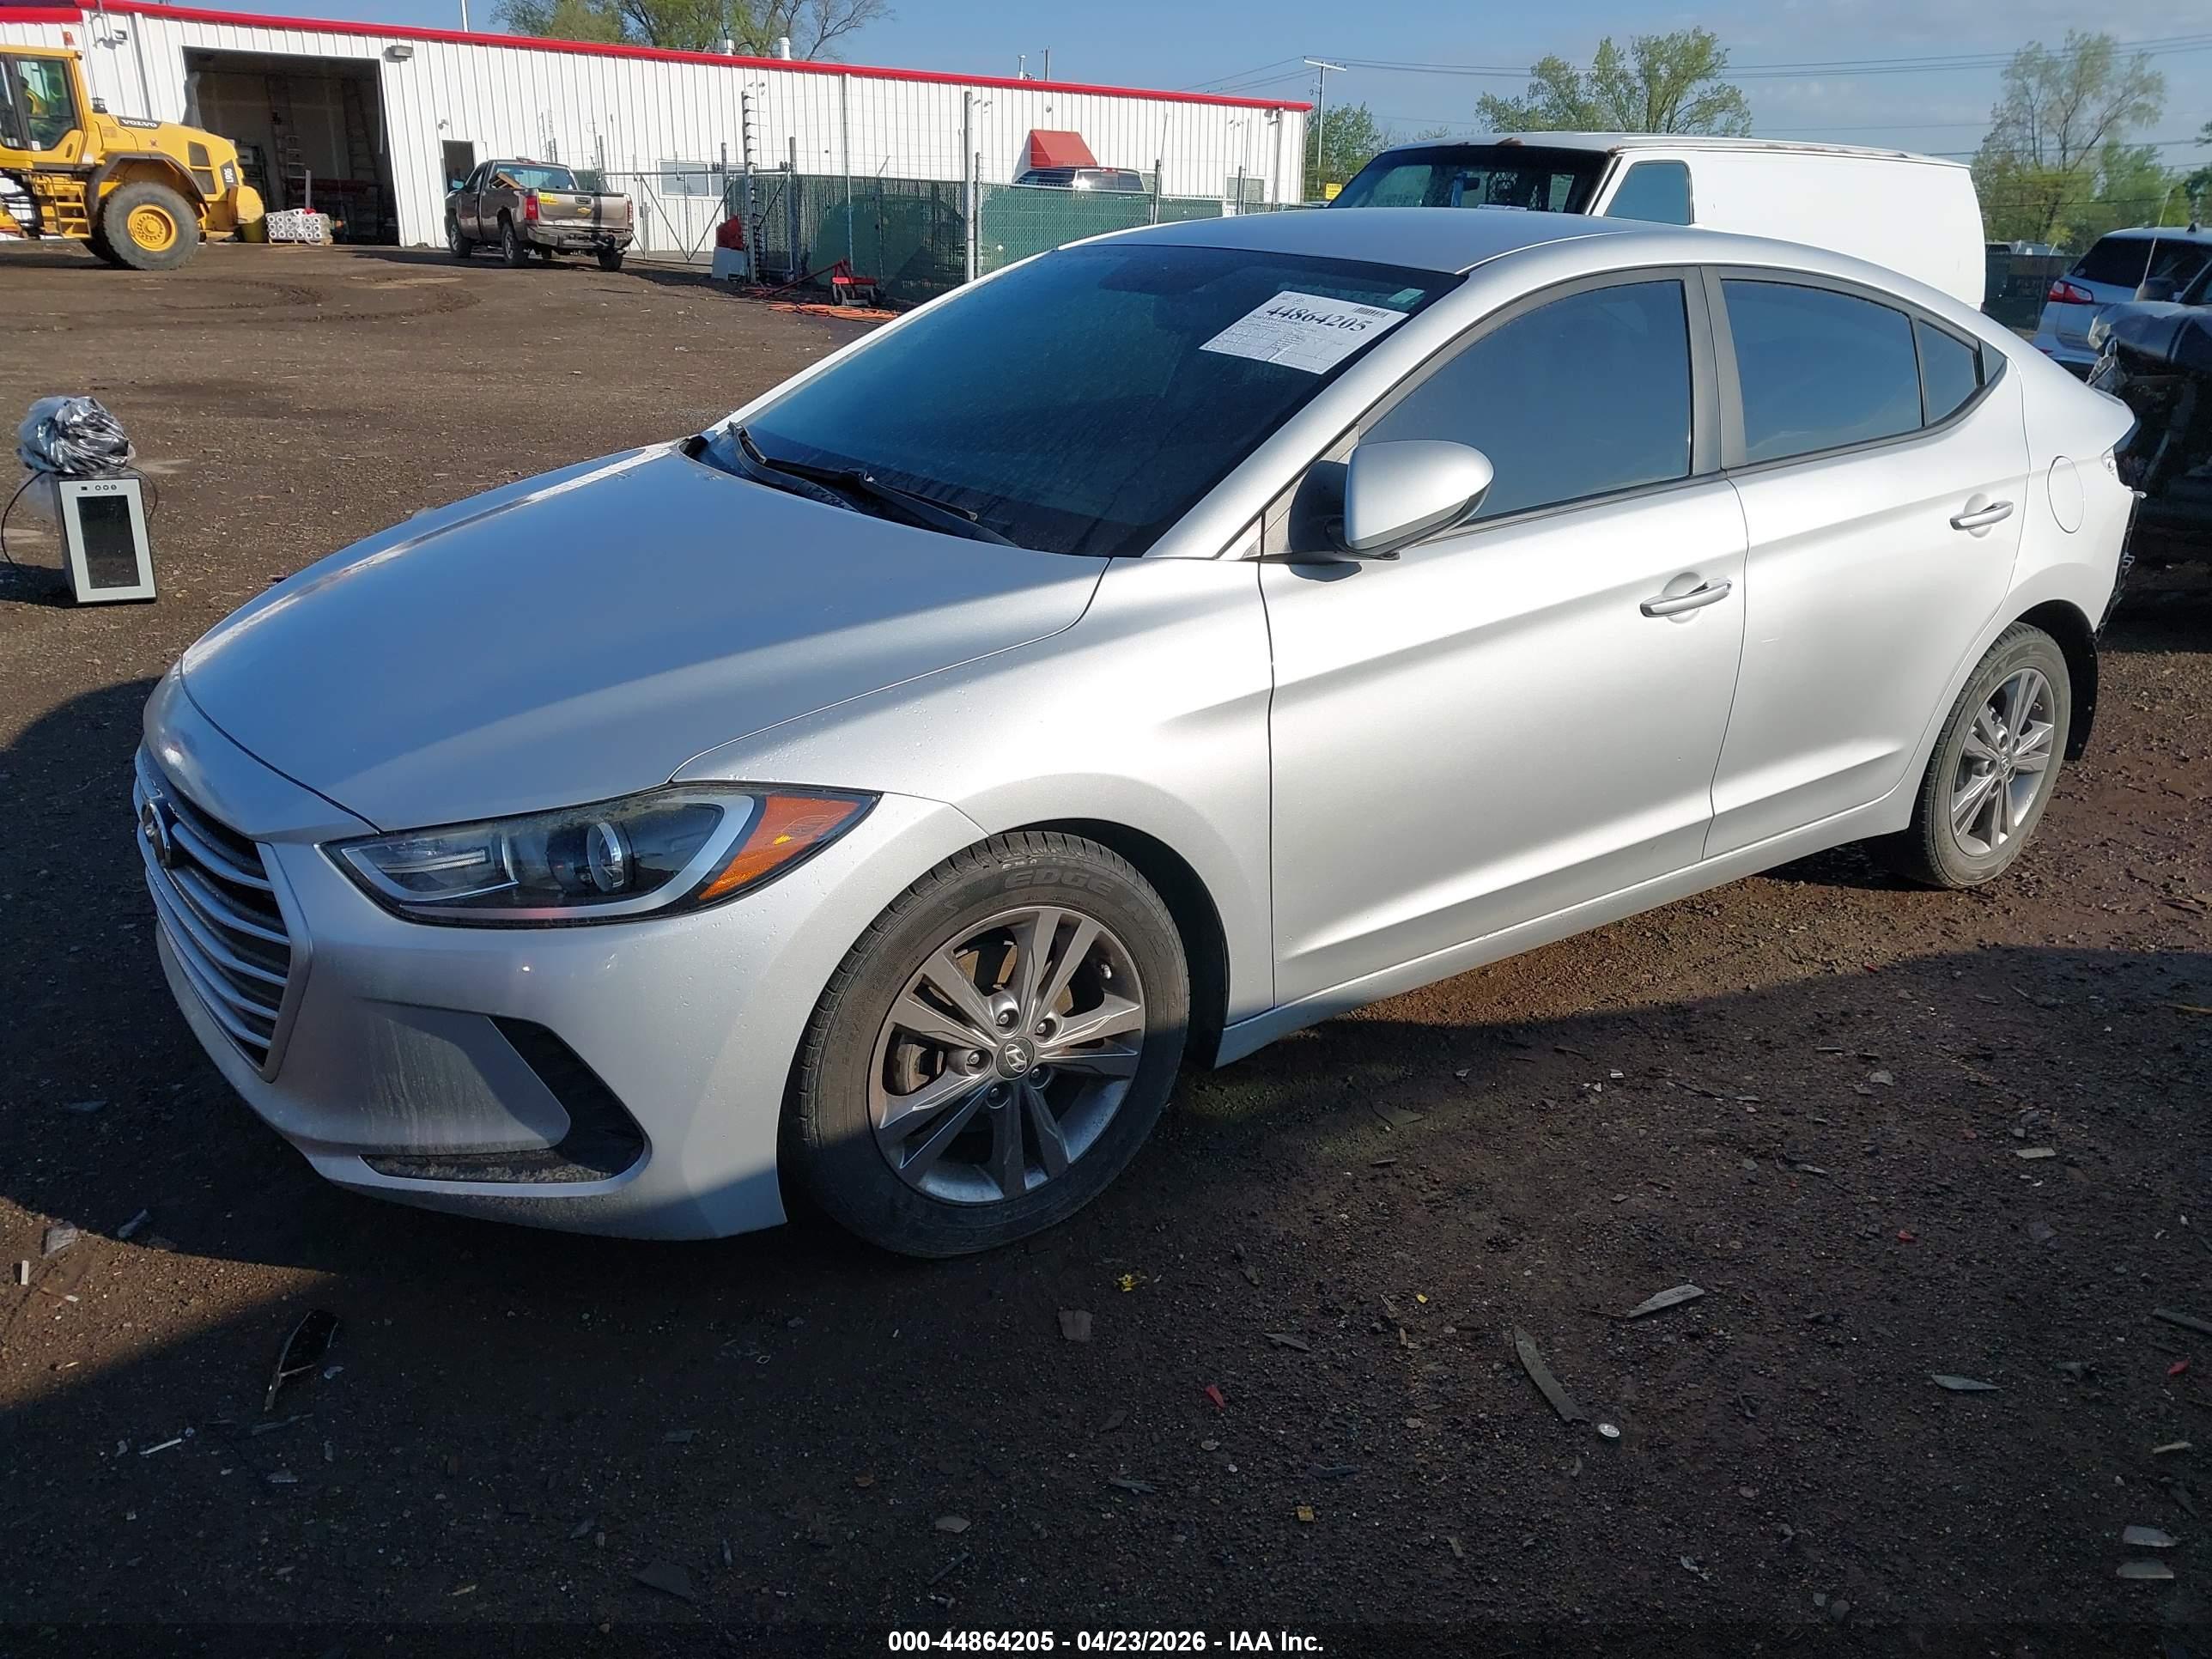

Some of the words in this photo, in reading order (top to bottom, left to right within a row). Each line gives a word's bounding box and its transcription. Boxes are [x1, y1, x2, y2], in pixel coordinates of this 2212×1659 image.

[121, 118, 158, 128] VOLVO
[1266, 305, 1374, 331] 44864205
[1003, 867, 1115, 896] EDGE
